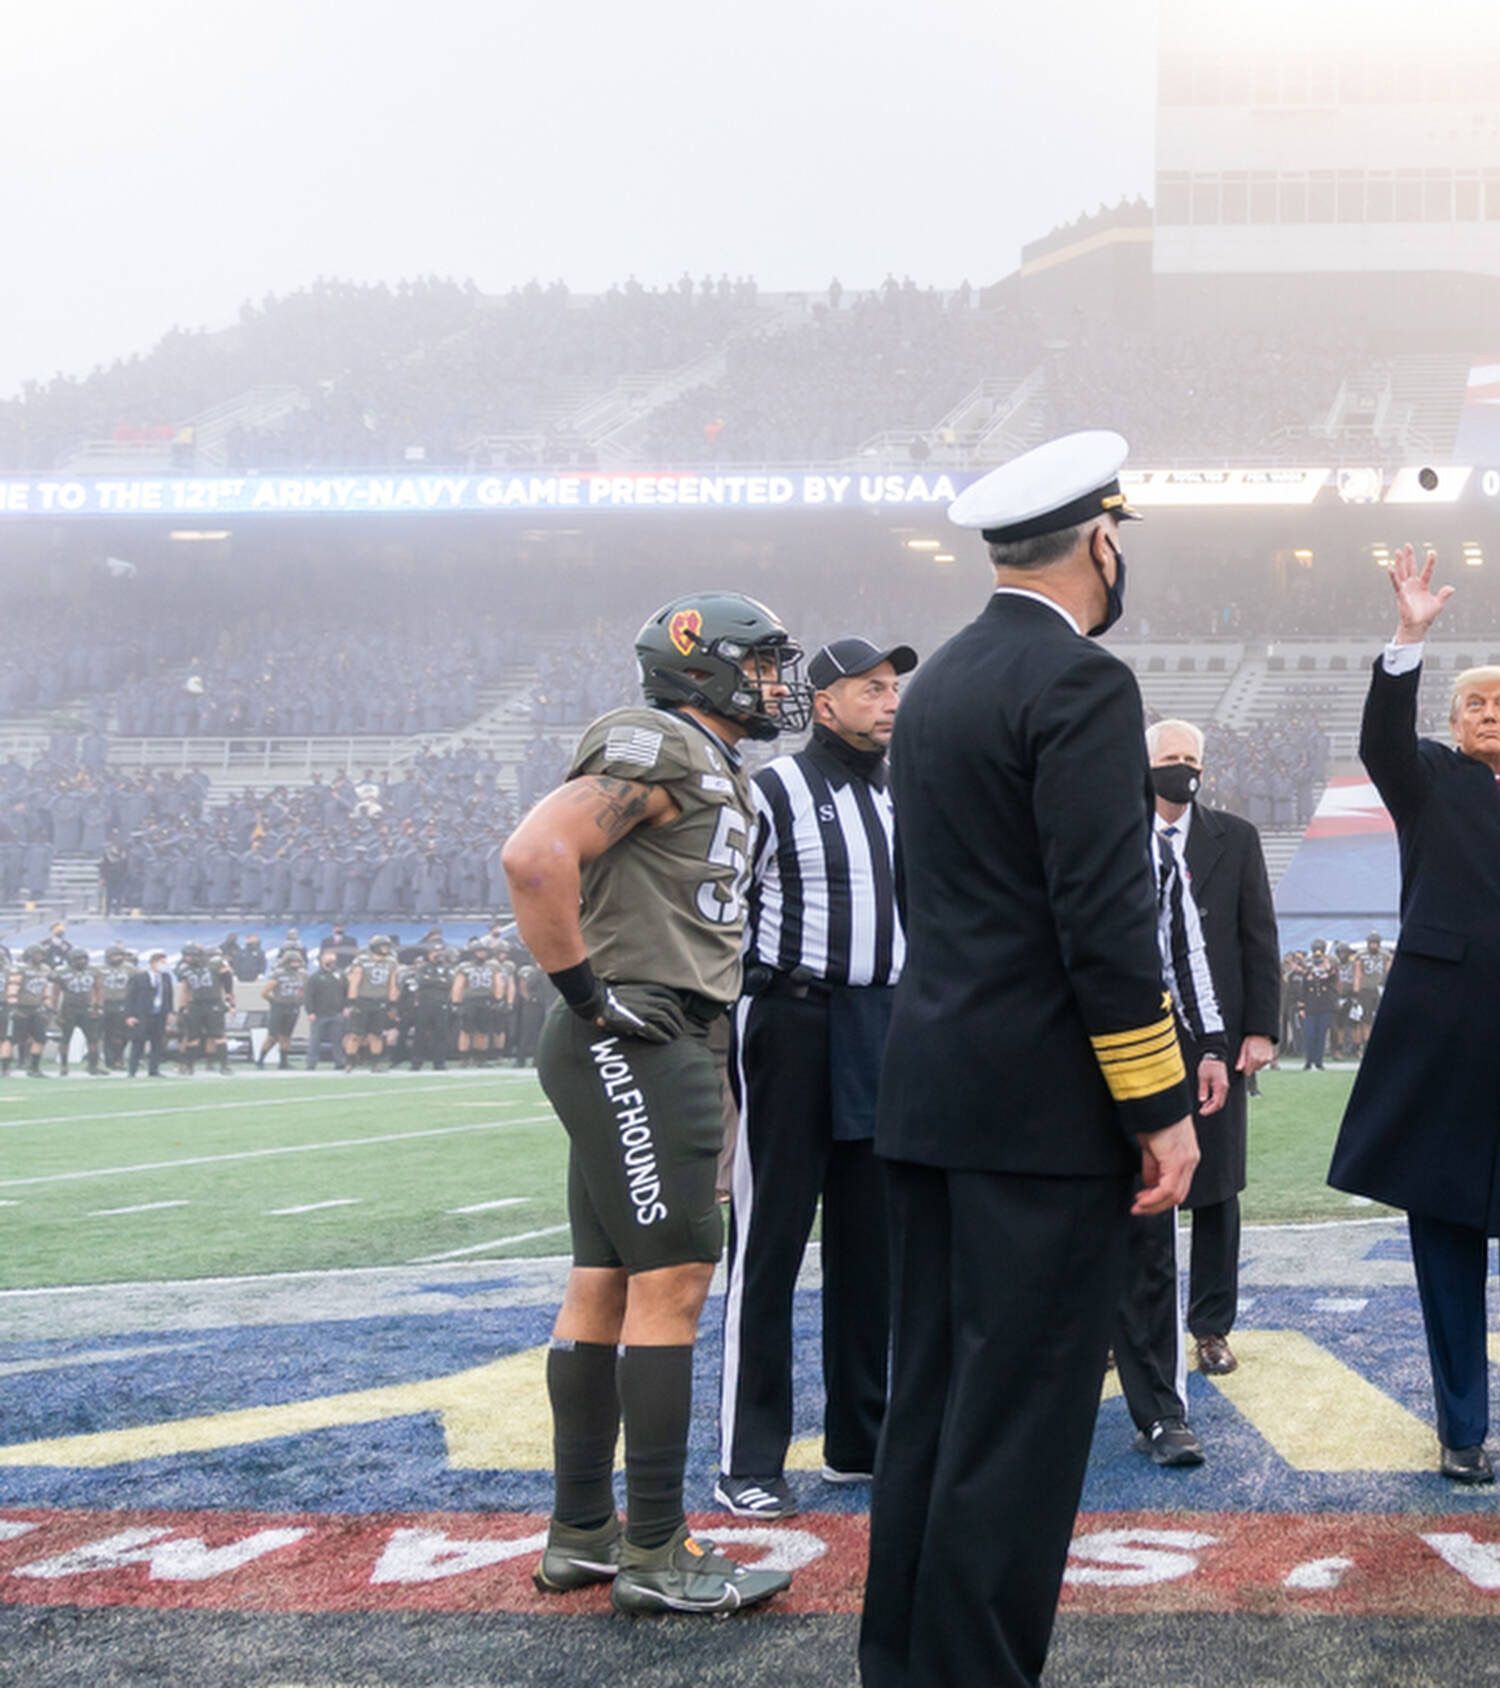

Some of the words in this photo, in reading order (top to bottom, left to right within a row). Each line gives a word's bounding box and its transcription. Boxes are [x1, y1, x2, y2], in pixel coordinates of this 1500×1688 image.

[0, 483, 29, 511] E
[37, 482, 87, 510] TO
[96, 481, 162, 509] THE
[252, 478, 468, 508] ARMY-NAVY
[477, 478, 580, 506] GAME
[589, 476, 793, 505] PRESENTED
[803, 476, 850, 503] BY
[860, 475, 954, 503] USAA
[819, 802, 834, 823] S
[589, 1036, 668, 1226] WOLFHOUNDS
